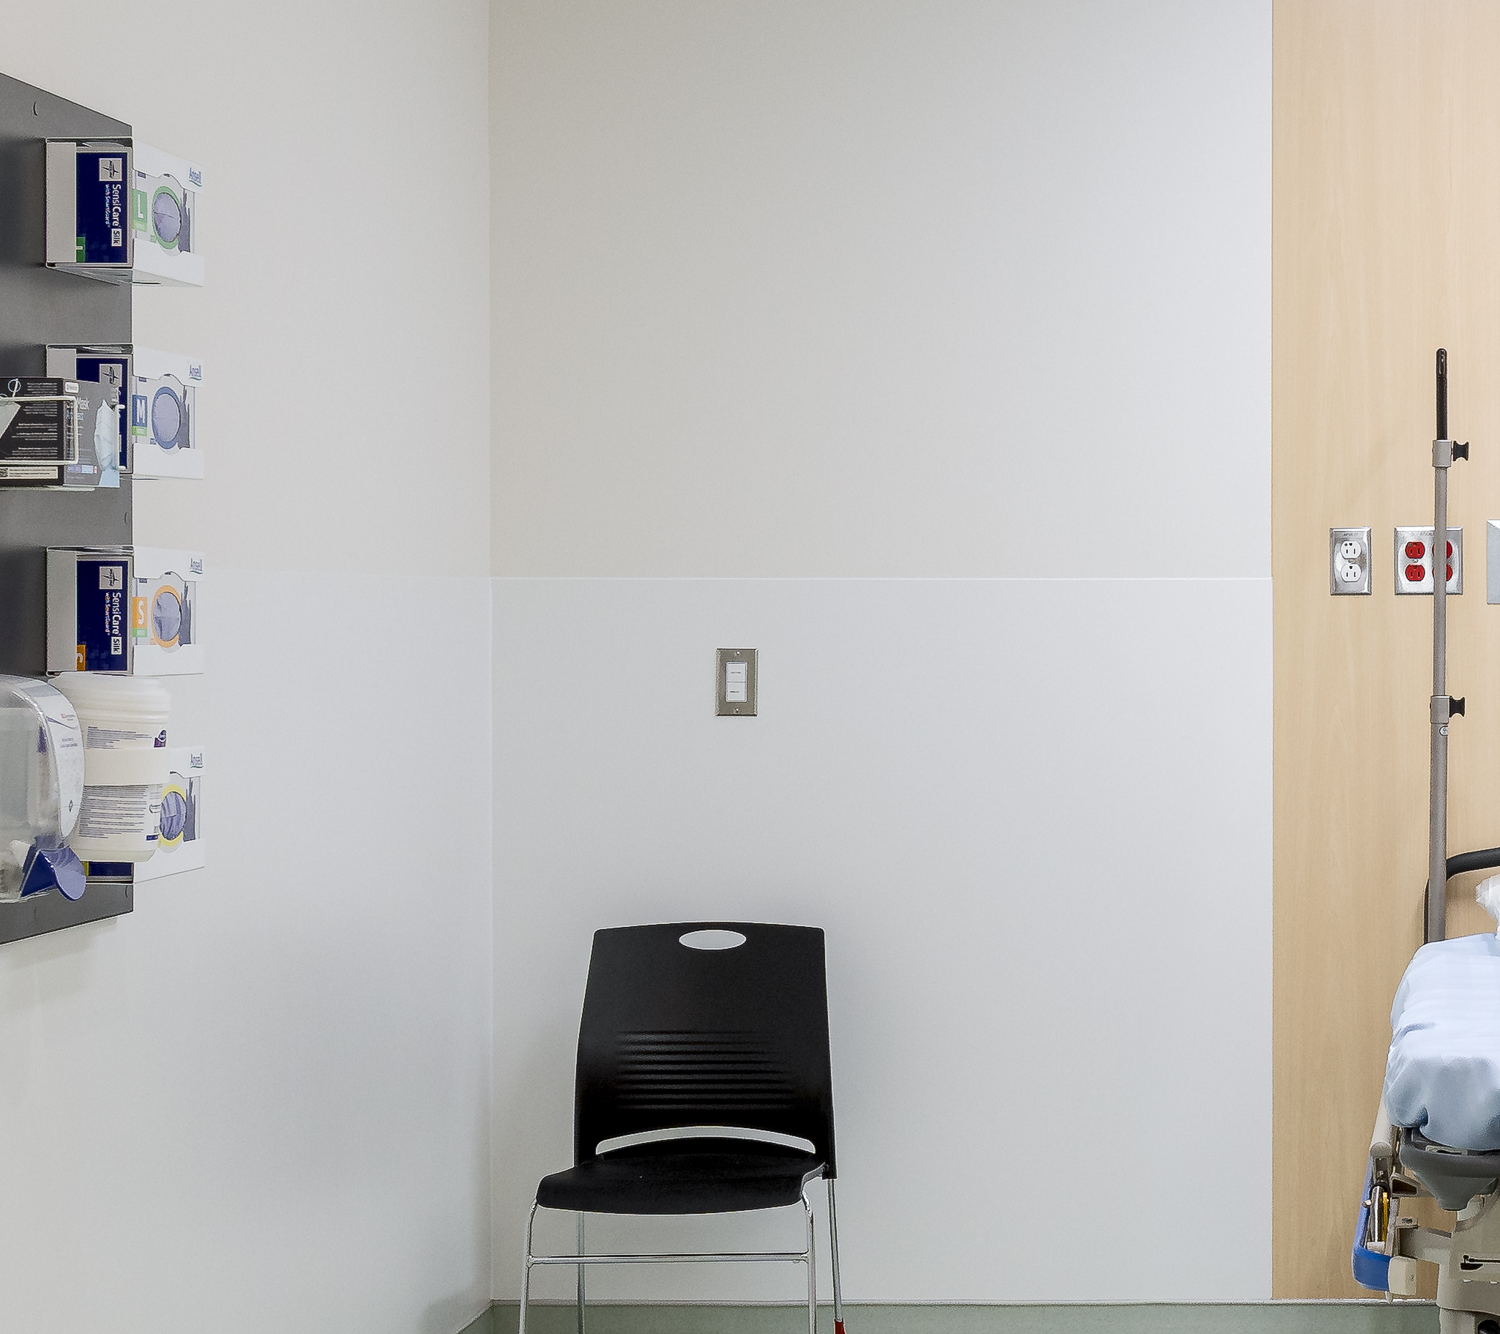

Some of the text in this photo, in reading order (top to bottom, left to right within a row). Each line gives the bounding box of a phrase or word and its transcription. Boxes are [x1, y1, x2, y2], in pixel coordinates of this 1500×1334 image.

[189, 167, 202, 184] Ansell
[138, 193, 143, 219] L
[136, 398, 145, 424] M
[112, 592, 121, 634] SensiCare
[137, 600, 145, 625] S
